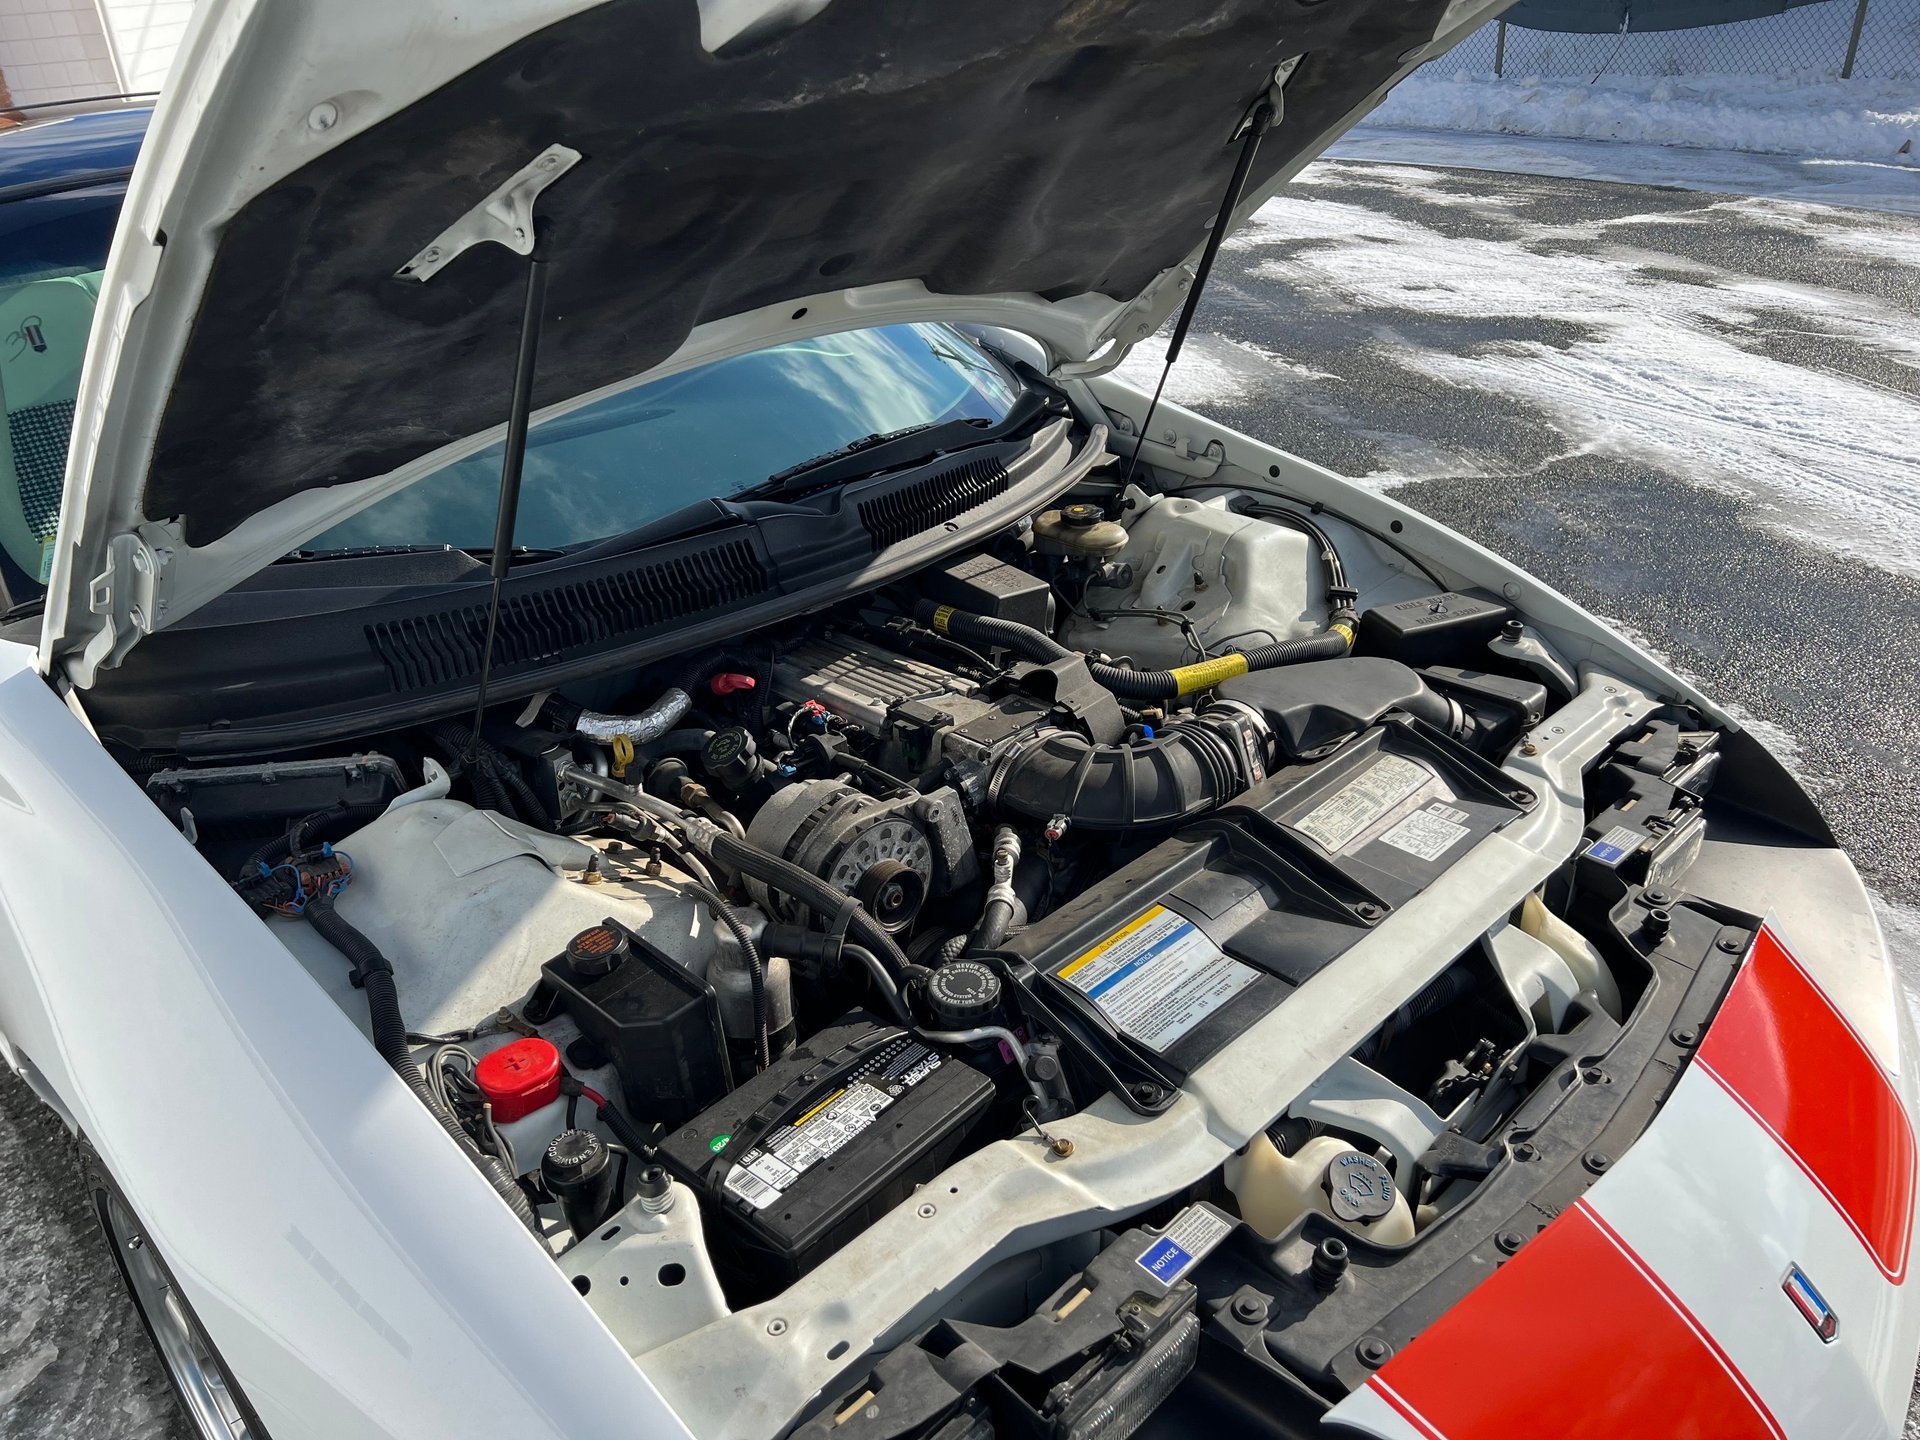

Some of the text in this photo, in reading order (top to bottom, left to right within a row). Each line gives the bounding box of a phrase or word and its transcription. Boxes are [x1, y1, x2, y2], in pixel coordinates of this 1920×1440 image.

[1107, 930, 1129, 946] CAUTION
[1133, 952, 1154, 968] NOTICE
[907, 1060, 942, 1086] SUPER
[712, 1137, 730, 1151] 4/20
[823, 1120, 872, 1159] DANGER/POISON
[742, 1149, 759, 1162] STD
[1340, 1155, 1378, 1172] WASHER
[1379, 1173, 1391, 1201] FLUID
[1151, 1246, 1179, 1272] NOTICE
